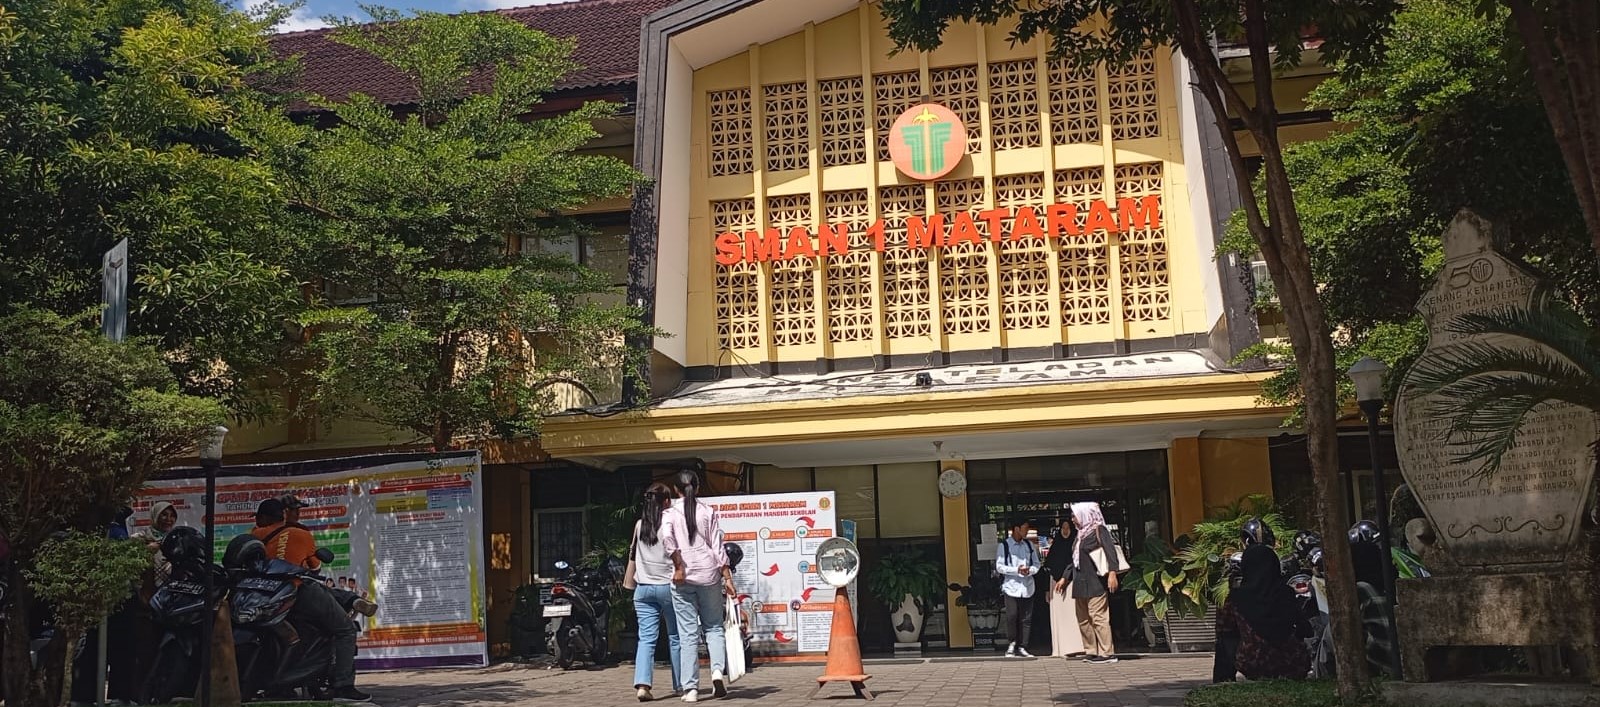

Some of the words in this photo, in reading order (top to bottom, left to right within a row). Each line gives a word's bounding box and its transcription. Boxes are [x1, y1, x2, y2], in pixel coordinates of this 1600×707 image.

[715, 223, 848, 265] SMAN
[866, 225, 885, 252] 1
[908, 195, 1160, 249] MATARAM
[1466, 276, 1526, 297] KENANGAN
[944, 356, 1173, 377] TELADAN
